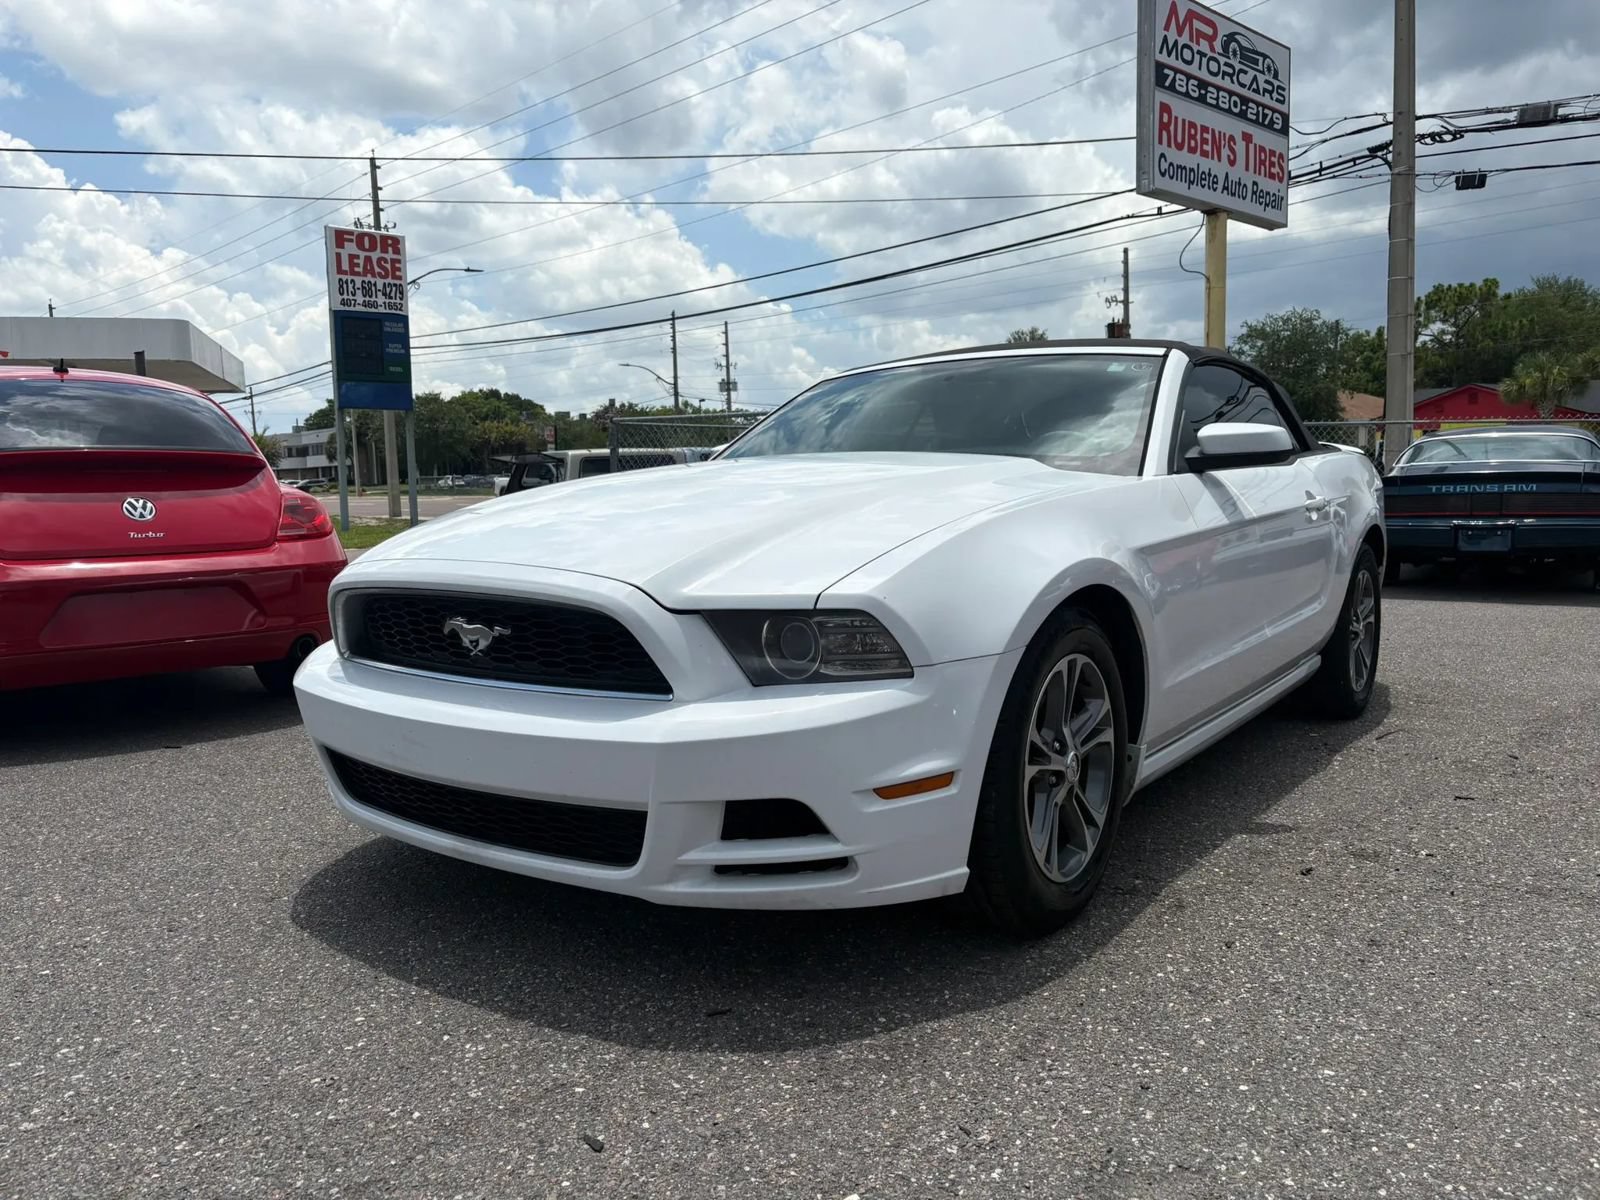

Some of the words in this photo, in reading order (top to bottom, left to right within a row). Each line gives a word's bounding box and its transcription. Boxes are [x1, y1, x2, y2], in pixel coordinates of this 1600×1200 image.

[1163, 0, 1218, 54] MR
[1159, 34, 1287, 105] MOTORCARS
[1163, 68, 1282, 130] 786-280-2179
[1158, 101, 1237, 168] RUBEN'S
[1242, 131, 1285, 185] TIRES
[1158, 152, 1219, 190] Complete
[1221, 171, 1248, 201] Auto
[1251, 180, 1284, 212] Repair
[334, 229, 402, 256] FOR
[335, 252, 403, 281] LEASE
[338, 278, 404, 301] 813-681-4279
[1427, 484, 1498, 493] TRANS
[1503, 483, 1537, 492] AM
[128, 531, 166, 539] Turbo
